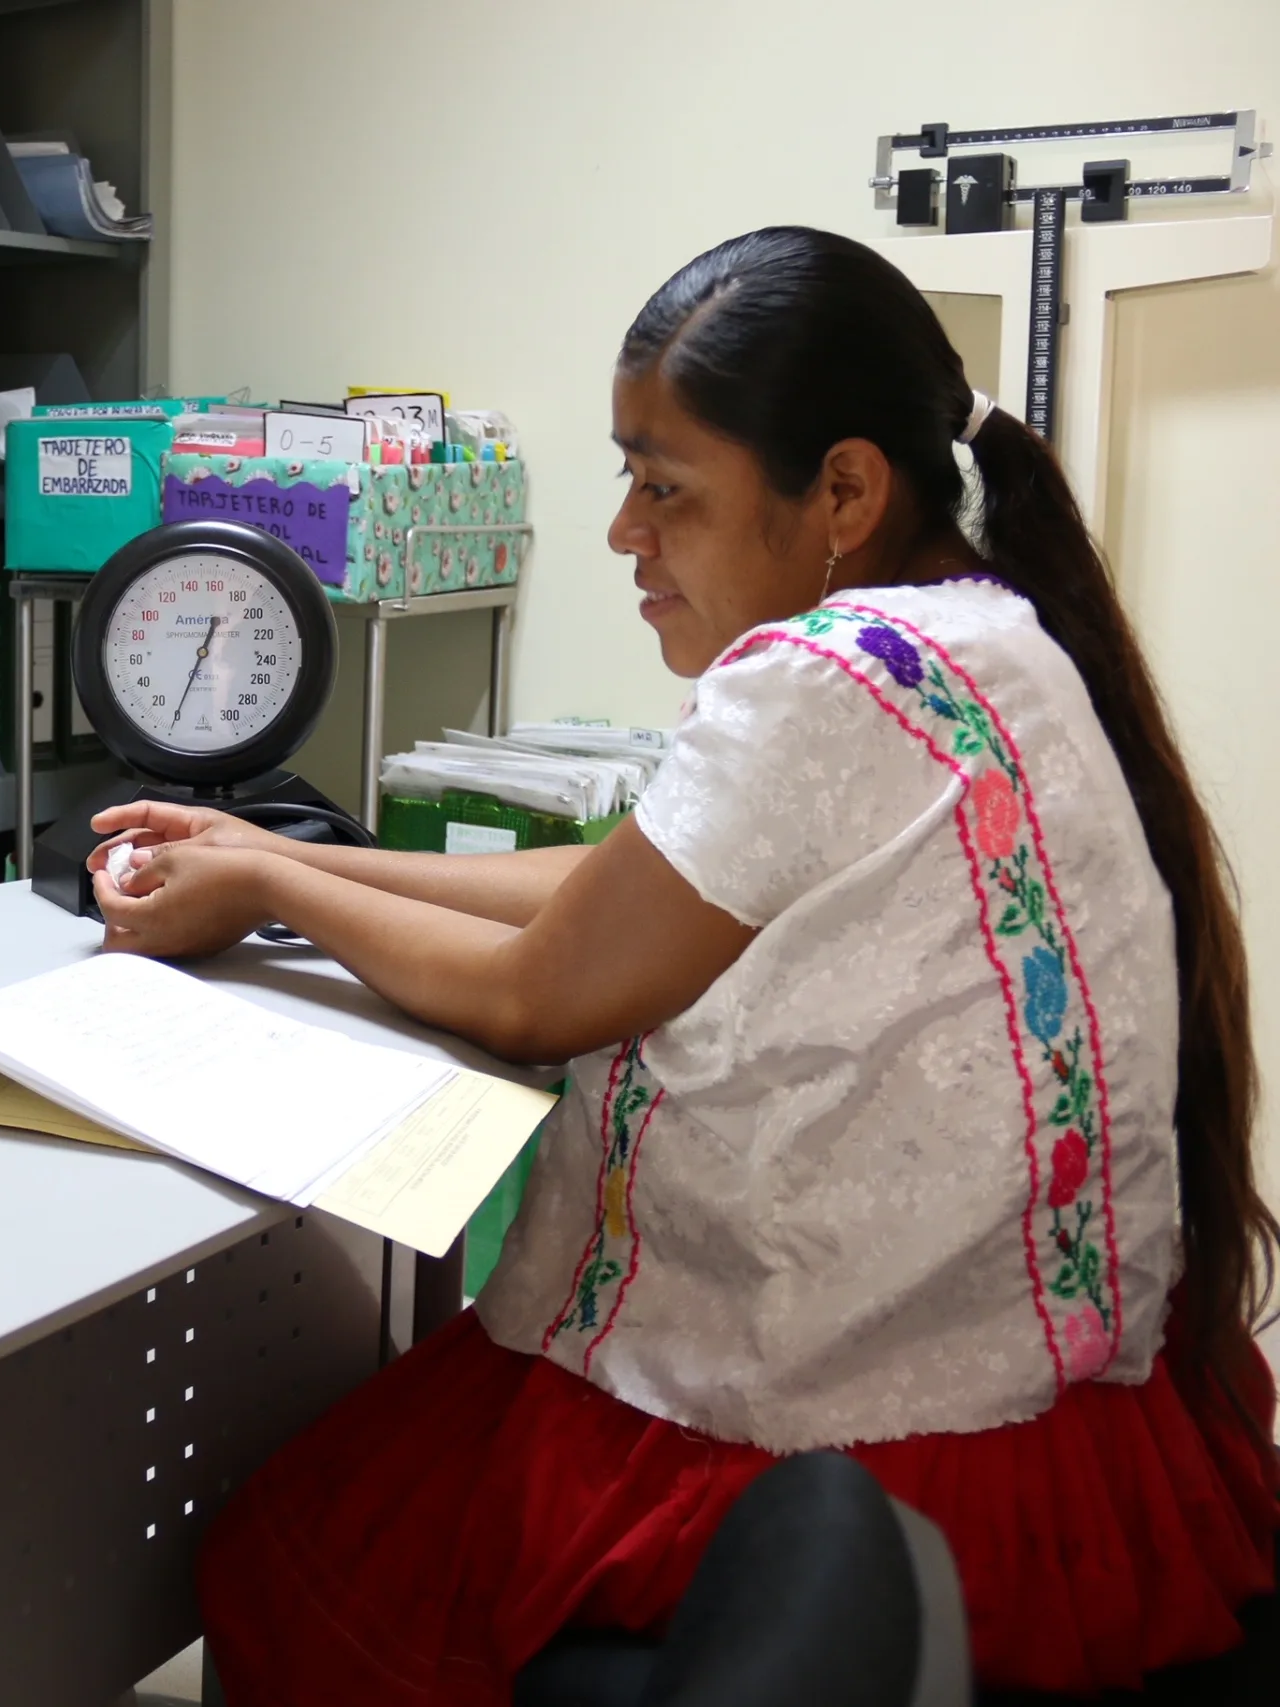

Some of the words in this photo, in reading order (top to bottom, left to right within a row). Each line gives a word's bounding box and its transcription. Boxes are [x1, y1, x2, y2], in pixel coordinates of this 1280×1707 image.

[1148, 186, 1167, 195] 120
[1173, 185, 1192, 193] 140
[42, 438, 125, 456] TARJETERO
[78, 458, 97, 477] DE
[42, 476, 129, 495] EMBARAZADA
[178, 490, 294, 517] TARJETERO
[308, 503, 327, 519] DE
[180, 580, 198, 592] 140
[206, 580, 224, 592] 160
[158, 592, 176, 603] 120
[229, 591, 246, 602] 180
[141, 611, 159, 621] 100
[243, 608, 263, 619] 200
[132, 630, 145, 641] 80
[254, 629, 274, 640] 220
[129, 654, 143, 665] 60
[256, 655, 276, 666] 240
[137, 676, 150, 687] 40
[251, 673, 270, 684] 260
[152, 695, 165, 706] 20
[238, 694, 257, 705] 280
[174, 710, 181, 721] 0
[220, 710, 239, 721] 300
